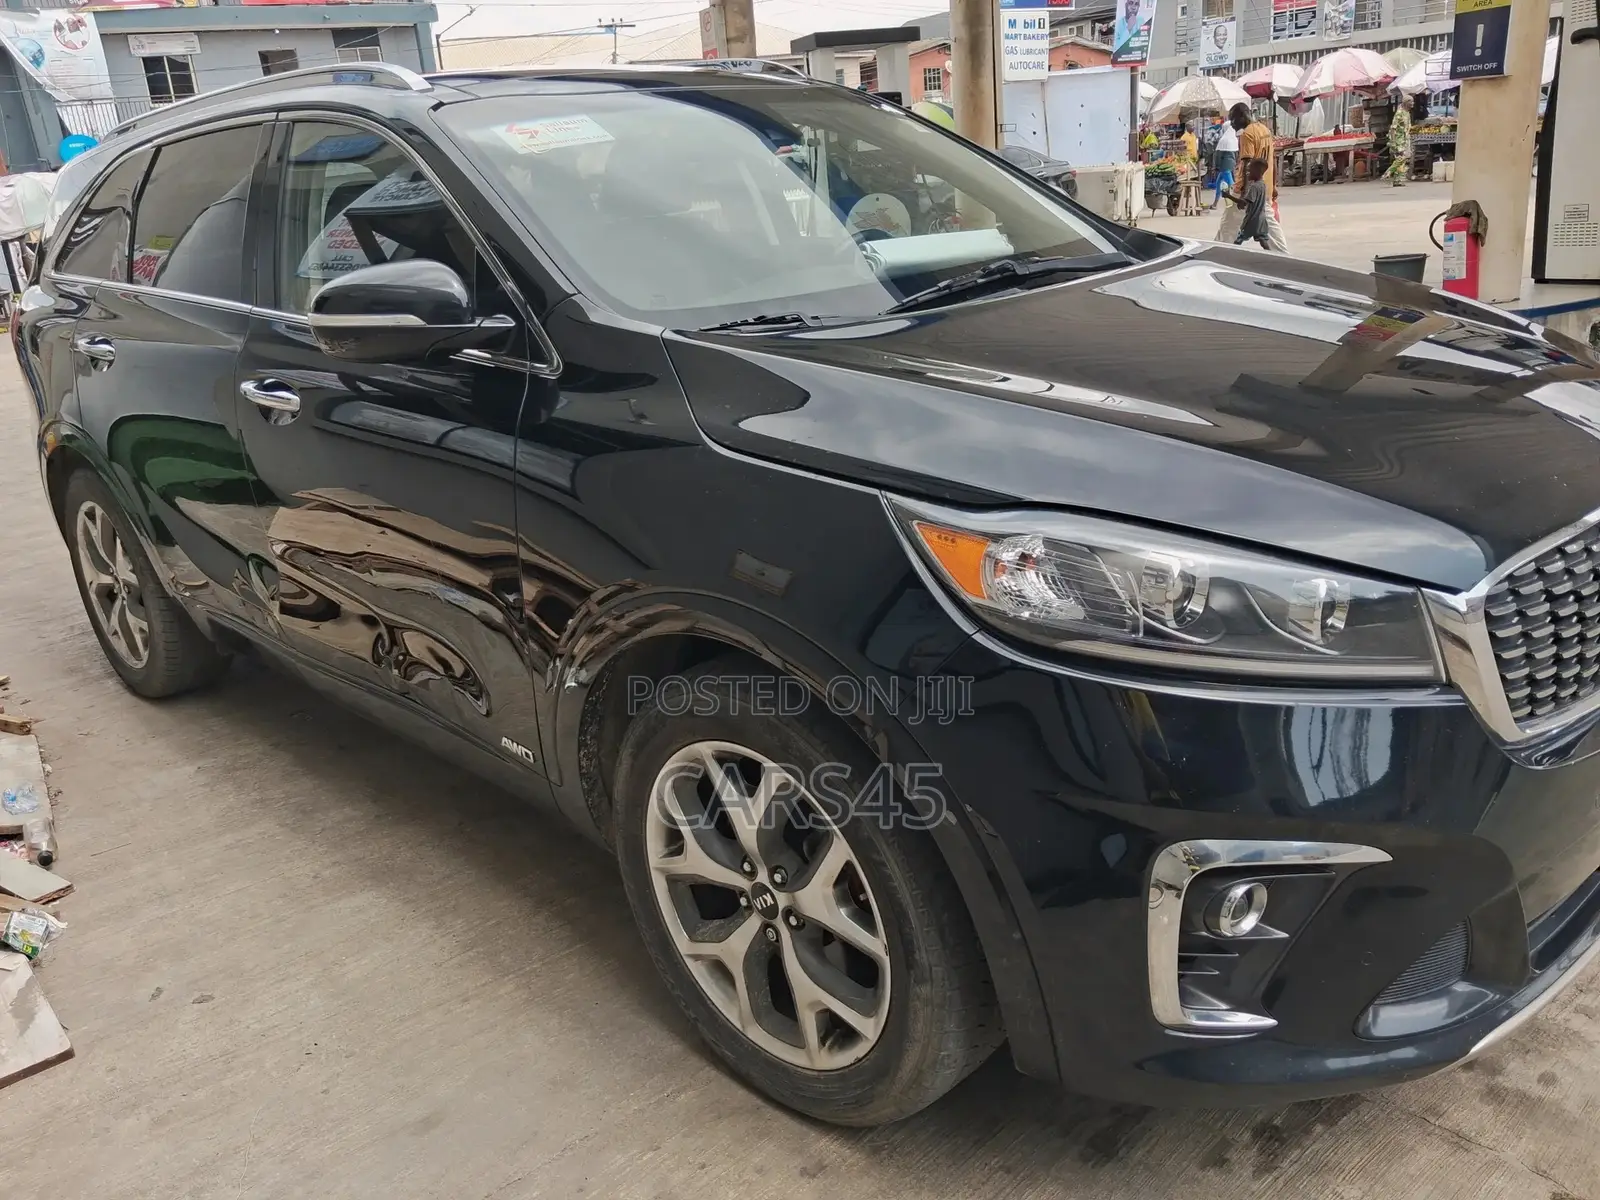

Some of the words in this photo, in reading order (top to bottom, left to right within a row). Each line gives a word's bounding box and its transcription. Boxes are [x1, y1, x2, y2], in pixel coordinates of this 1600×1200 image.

[1473, 0, 1492, 8] AREA
[1005, 46, 1018, 55] GAS
[1206, 54, 1228, 62] OLOWO
[1009, 61, 1045, 70] AUTOCARE
[1456, 64, 1482, 72] SWITCH
[1484, 62, 1498, 70] OFF
[501, 736, 535, 763] AWD
[753, 892, 775, 910] KIA
